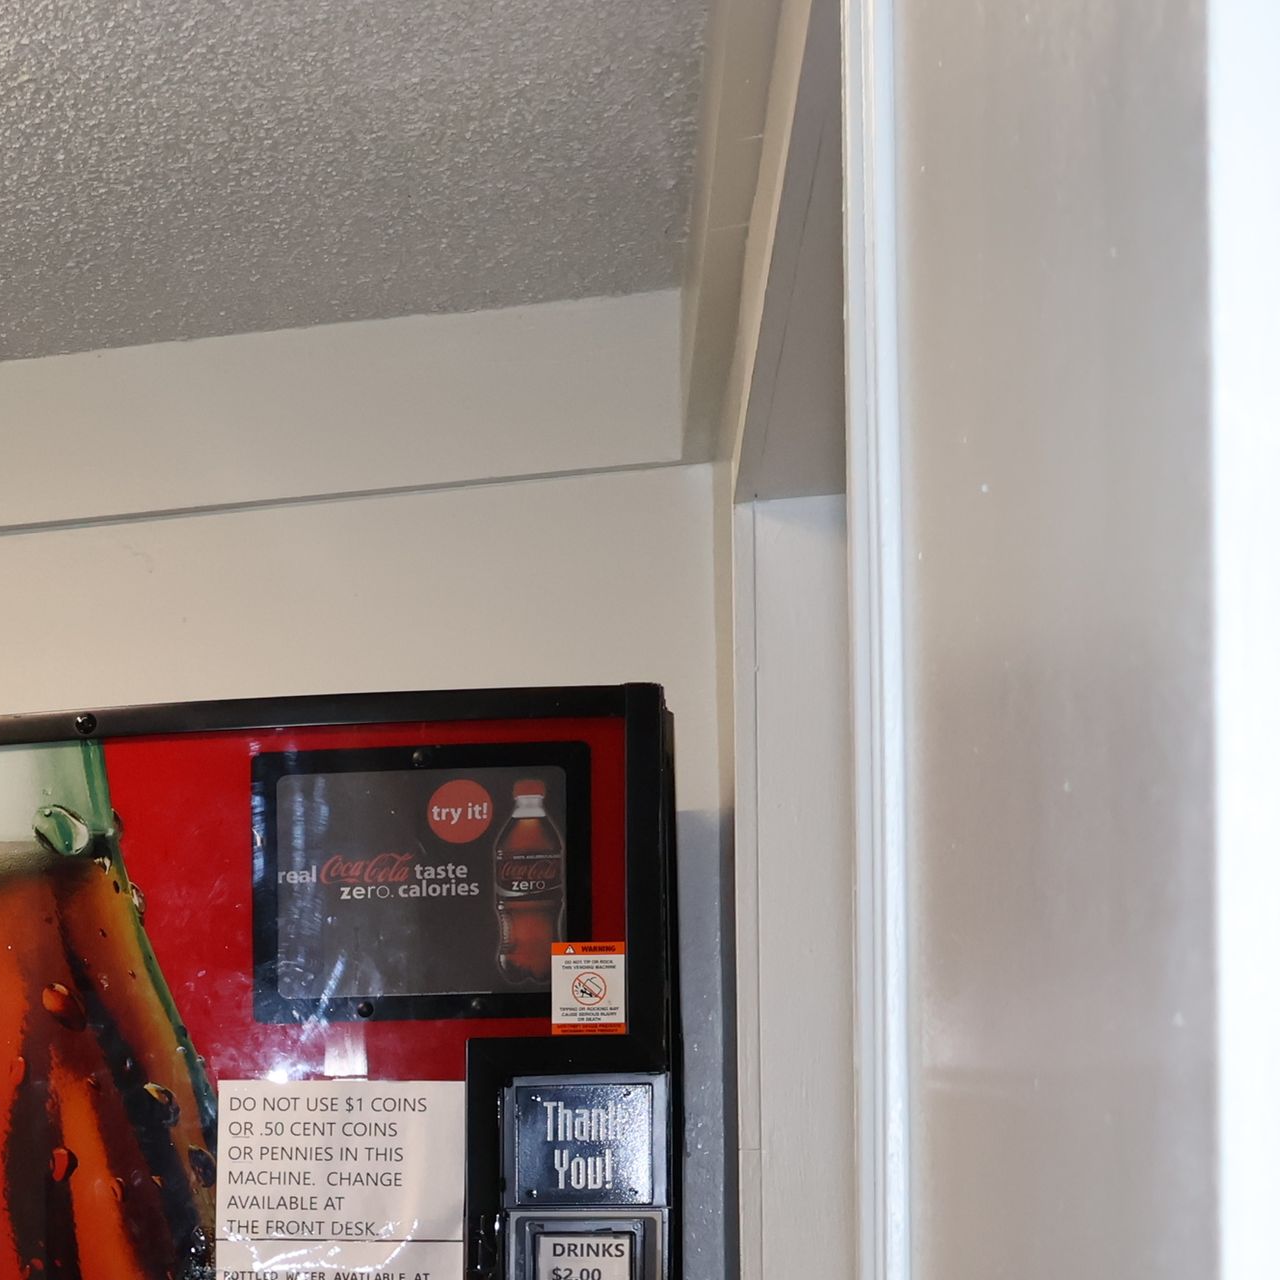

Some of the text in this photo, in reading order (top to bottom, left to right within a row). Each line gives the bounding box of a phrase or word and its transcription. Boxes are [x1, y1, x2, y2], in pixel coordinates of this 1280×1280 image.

[432, 803, 489, 824] try it!
[278, 865, 317, 884] real
[414, 863, 468, 879] taste
[398, 879, 479, 897] calories
[512, 881, 545, 890] zero
[230, 1097, 427, 1113] DO NOT USE $1 COINS
[228, 1122, 398, 1137] OR .50 CENT COINS
[228, 1146, 404, 1162] OR PENNIES IN THIS
[228, 1171, 402, 1187] MACHINE. CHANGE
[227, 1196, 345, 1210] AVAILABLE AT
[227, 1220, 379, 1236] THE FRONT DESK.
[552, 1243, 624, 1257] DRINKS
